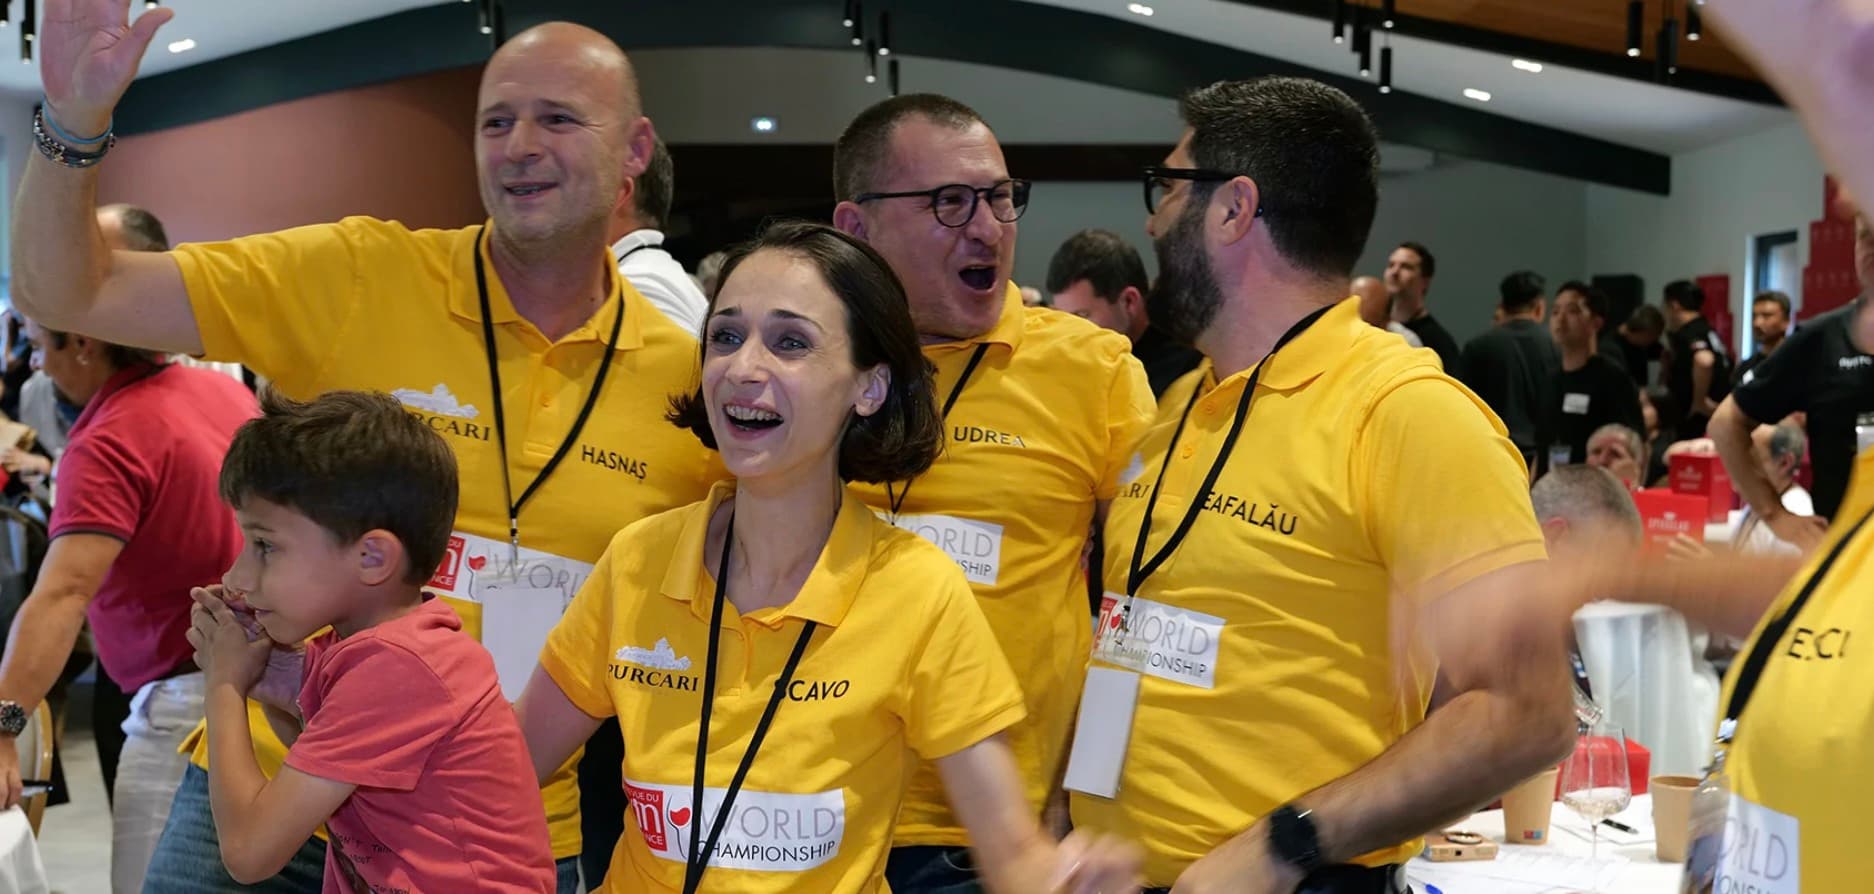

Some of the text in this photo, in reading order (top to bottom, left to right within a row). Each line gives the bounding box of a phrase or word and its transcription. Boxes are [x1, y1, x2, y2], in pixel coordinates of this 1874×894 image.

[953, 426, 1026, 449] UDREA
[1200, 489, 1298, 536] EAFALĂU
[494, 553, 588, 599] WORL
[1128, 611, 1210, 656] WORLD
[701, 803, 837, 840] WORLD
